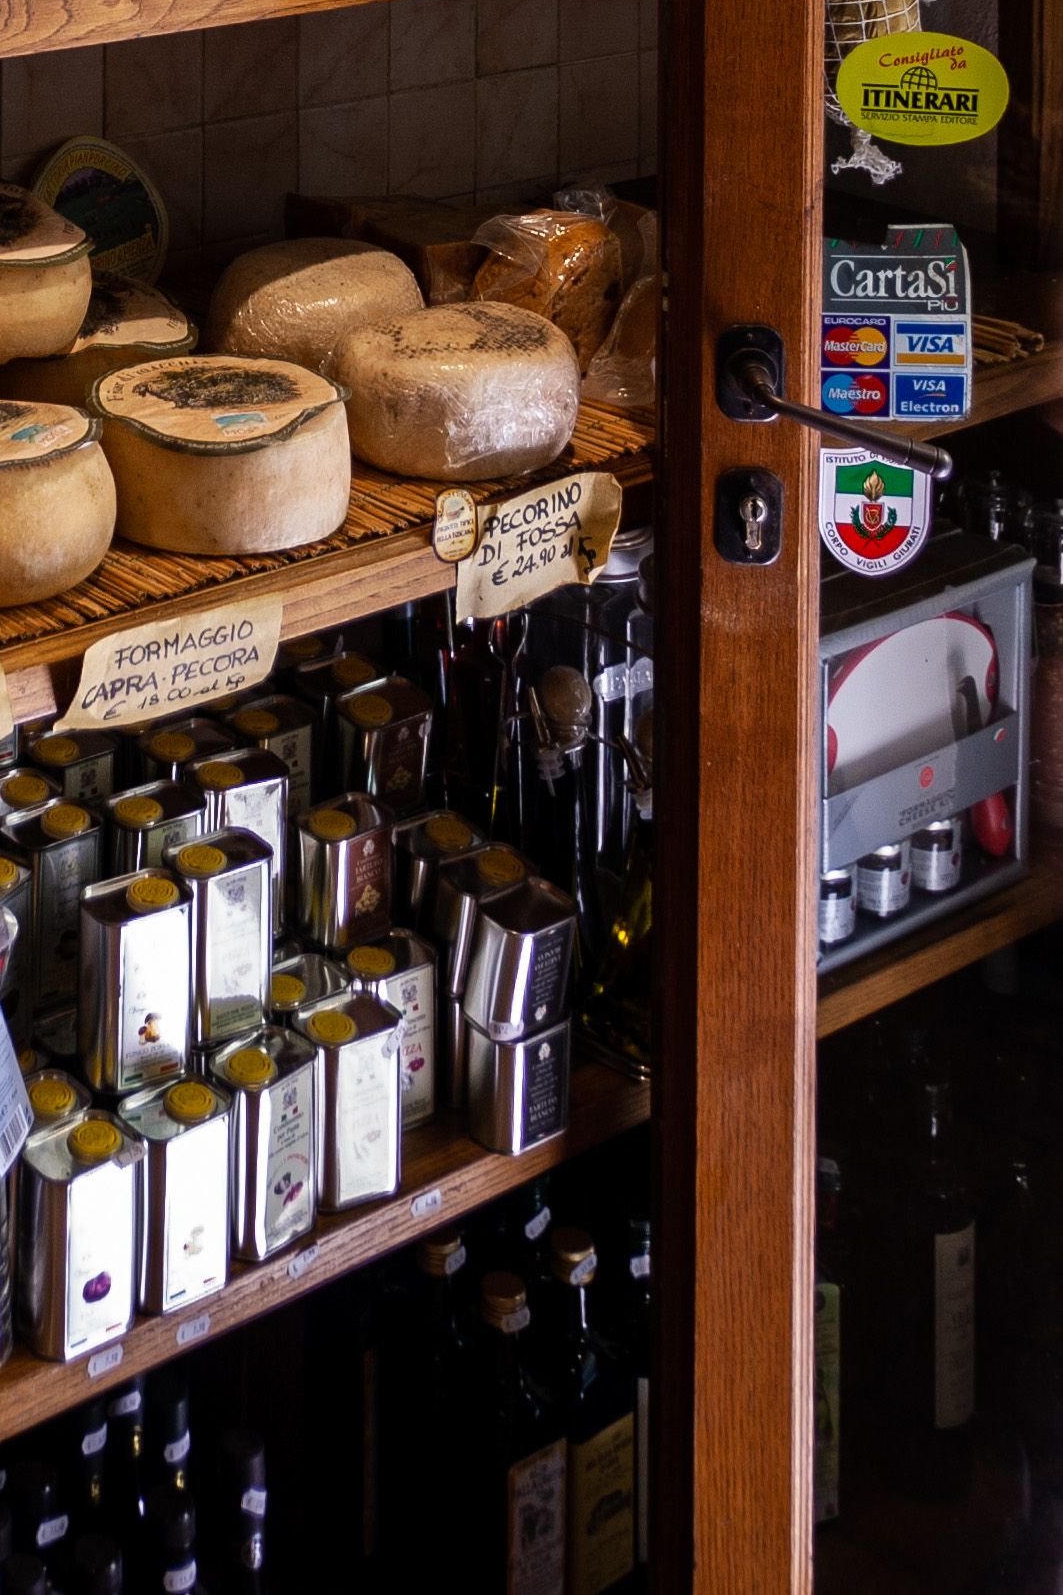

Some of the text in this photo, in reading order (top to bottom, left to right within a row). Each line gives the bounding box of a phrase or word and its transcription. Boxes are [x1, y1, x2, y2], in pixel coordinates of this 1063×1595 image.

[878, 46, 964, 68] Consigliato
[950, 57, 967, 72] da
[862, 89, 978, 113] ITINERARI
[860, 111, 978, 126] SERVIZIO STAMPA EDITORE
[824, 317, 886, 326] EUROCARD
[824, 340, 887, 353] MasterCard
[907, 336, 954, 353] VISA
[828, 387, 881, 401] Maestro
[912, 379, 946, 391] VISA
[901, 401, 959, 413] Electron
[826, 454, 866, 464] ISTITUTO
[484, 482, 581, 538] PECORINO
[478, 511, 581, 567] DI FOSSA
[825, 521, 921, 569] CORPO VIGILI GIURATI
[492, 560, 509, 586] €
[561, 535, 575, 559] al
[115, 619, 253, 669] FORMAGGIO
[82, 646, 259, 709] CAPRA PECORA
[103, 700, 127, 720] €
